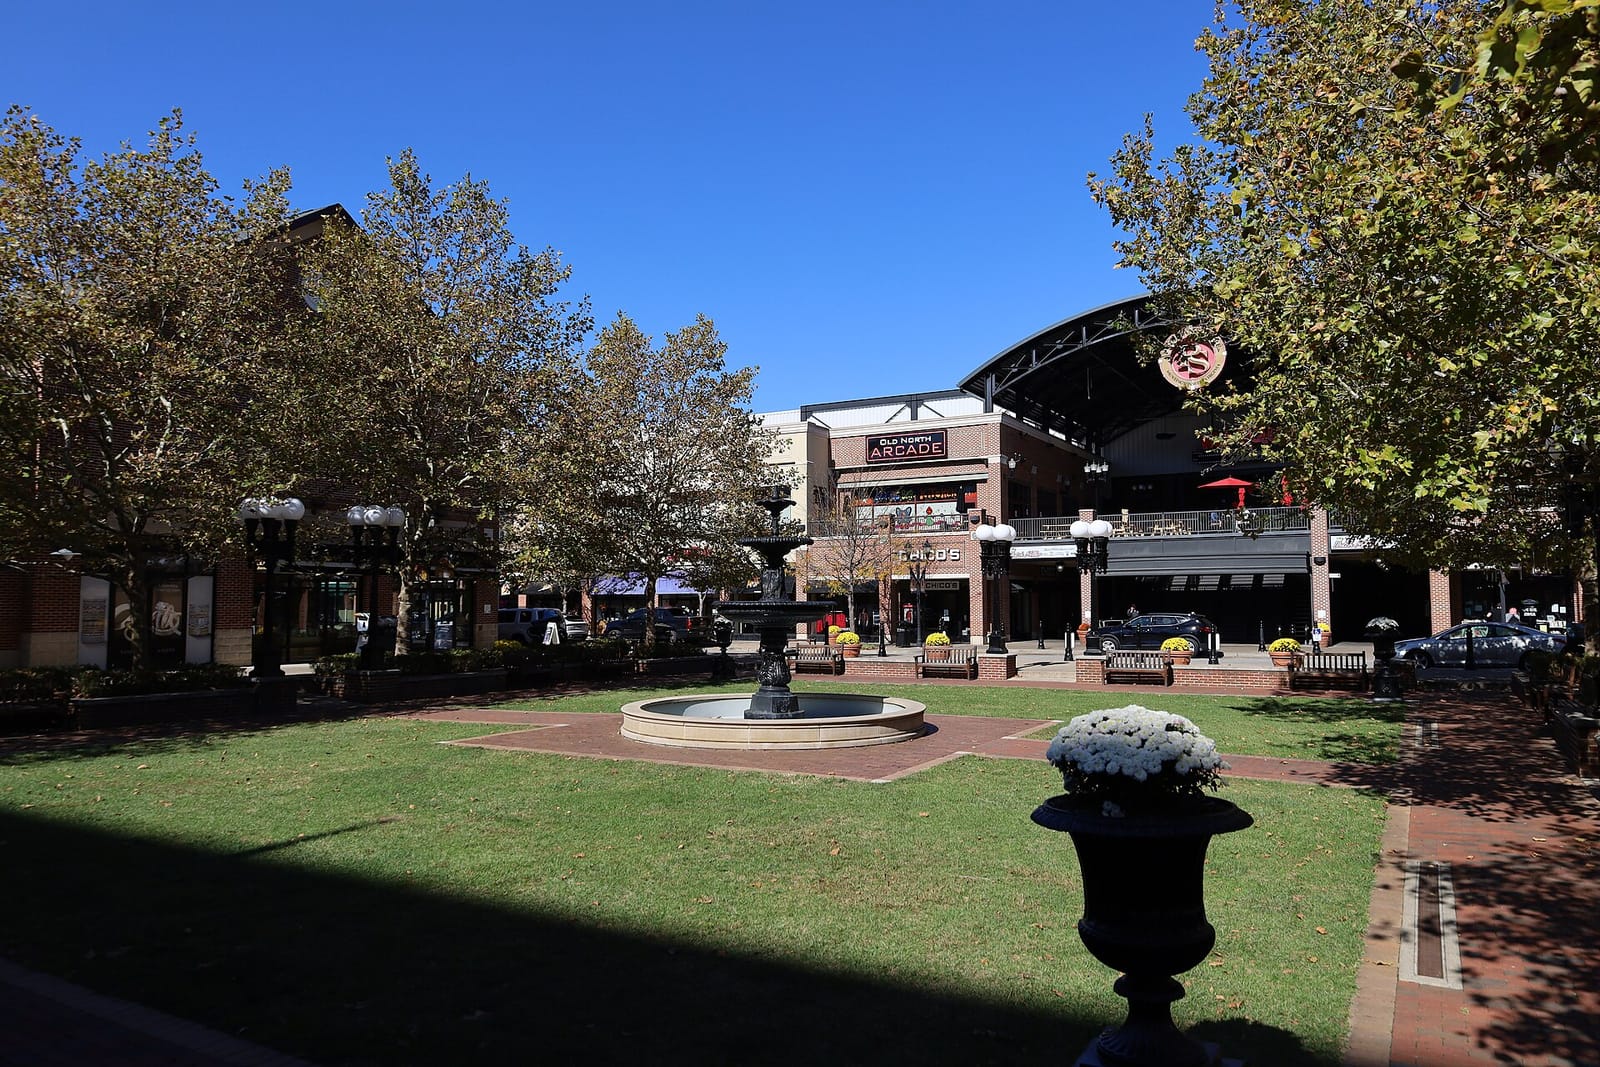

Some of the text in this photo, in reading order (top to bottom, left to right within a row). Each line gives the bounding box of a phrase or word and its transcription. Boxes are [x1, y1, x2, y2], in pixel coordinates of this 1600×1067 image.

[900, 436, 932, 444] NORTH
[870, 442, 943, 458] ARCADE
[898, 548, 960, 561] CHICO'S
